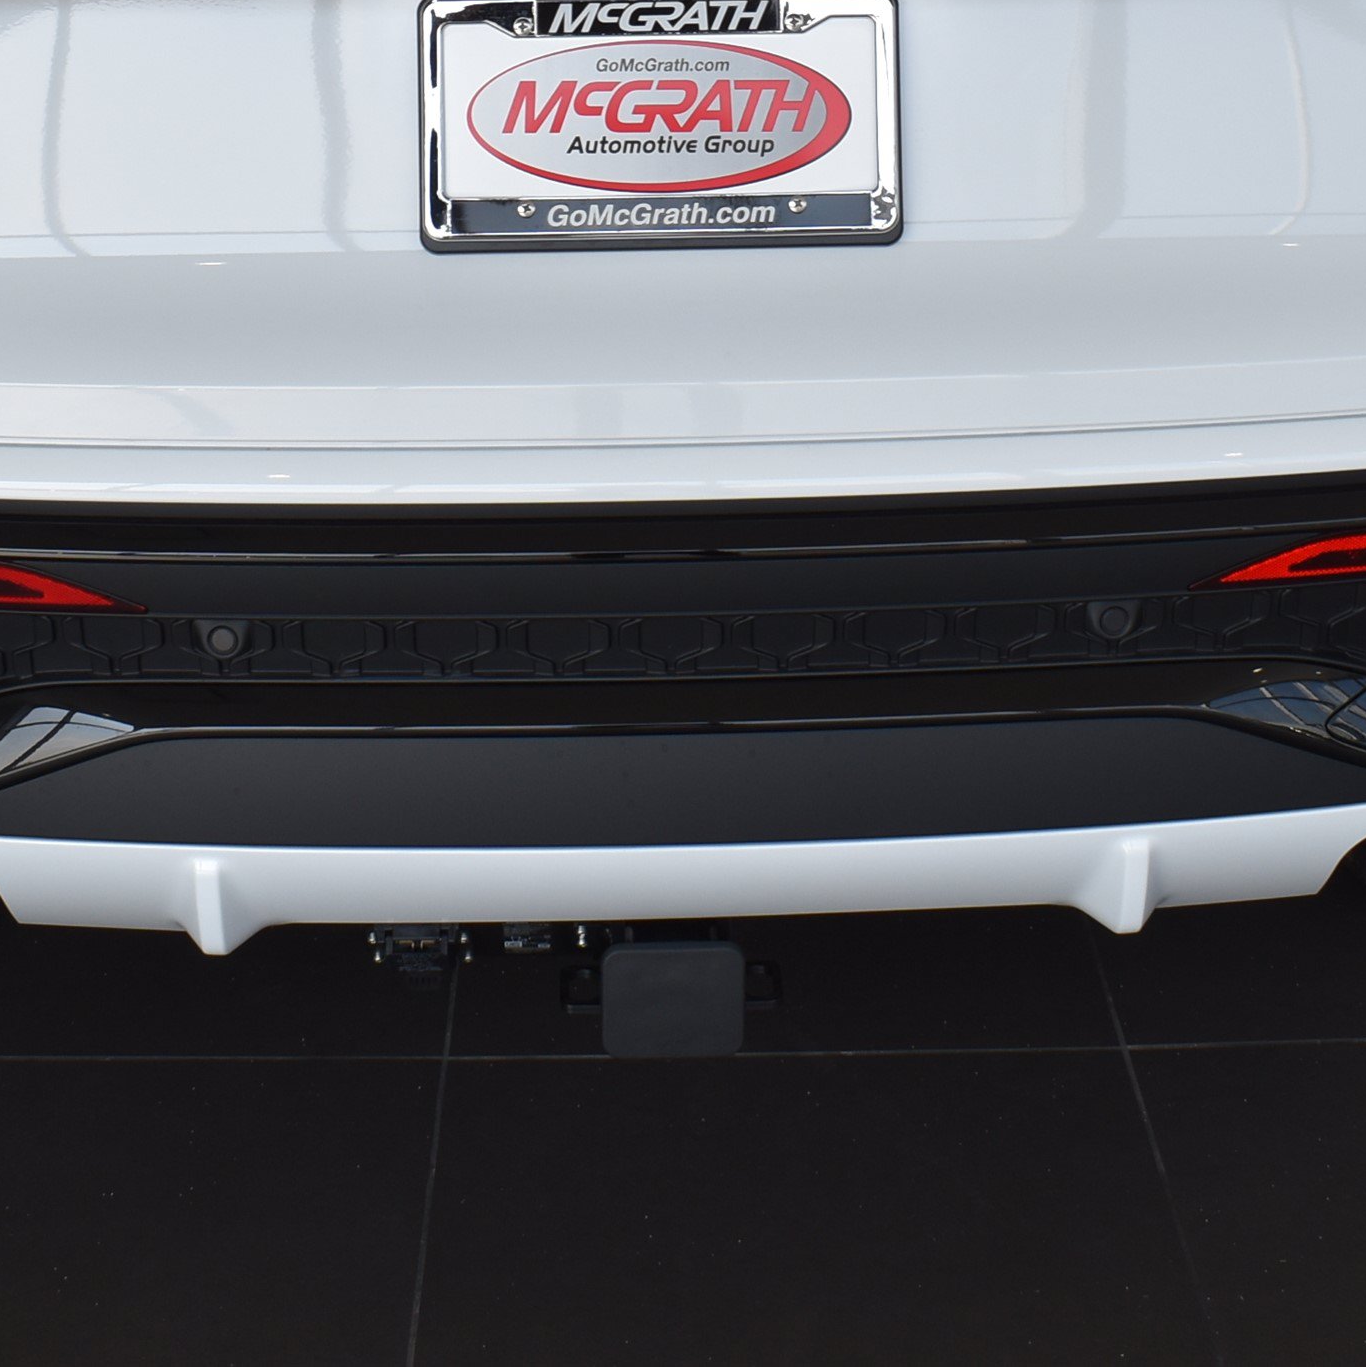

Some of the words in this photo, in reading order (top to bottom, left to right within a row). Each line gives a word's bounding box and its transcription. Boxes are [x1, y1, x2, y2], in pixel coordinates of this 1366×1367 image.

[596, 57, 730, 73] GoMcGrath.com
[567, 135, 698, 155] Automotive
[704, 135, 775, 157] Group
[547, 202, 777, 228] GoMcGrath.com
